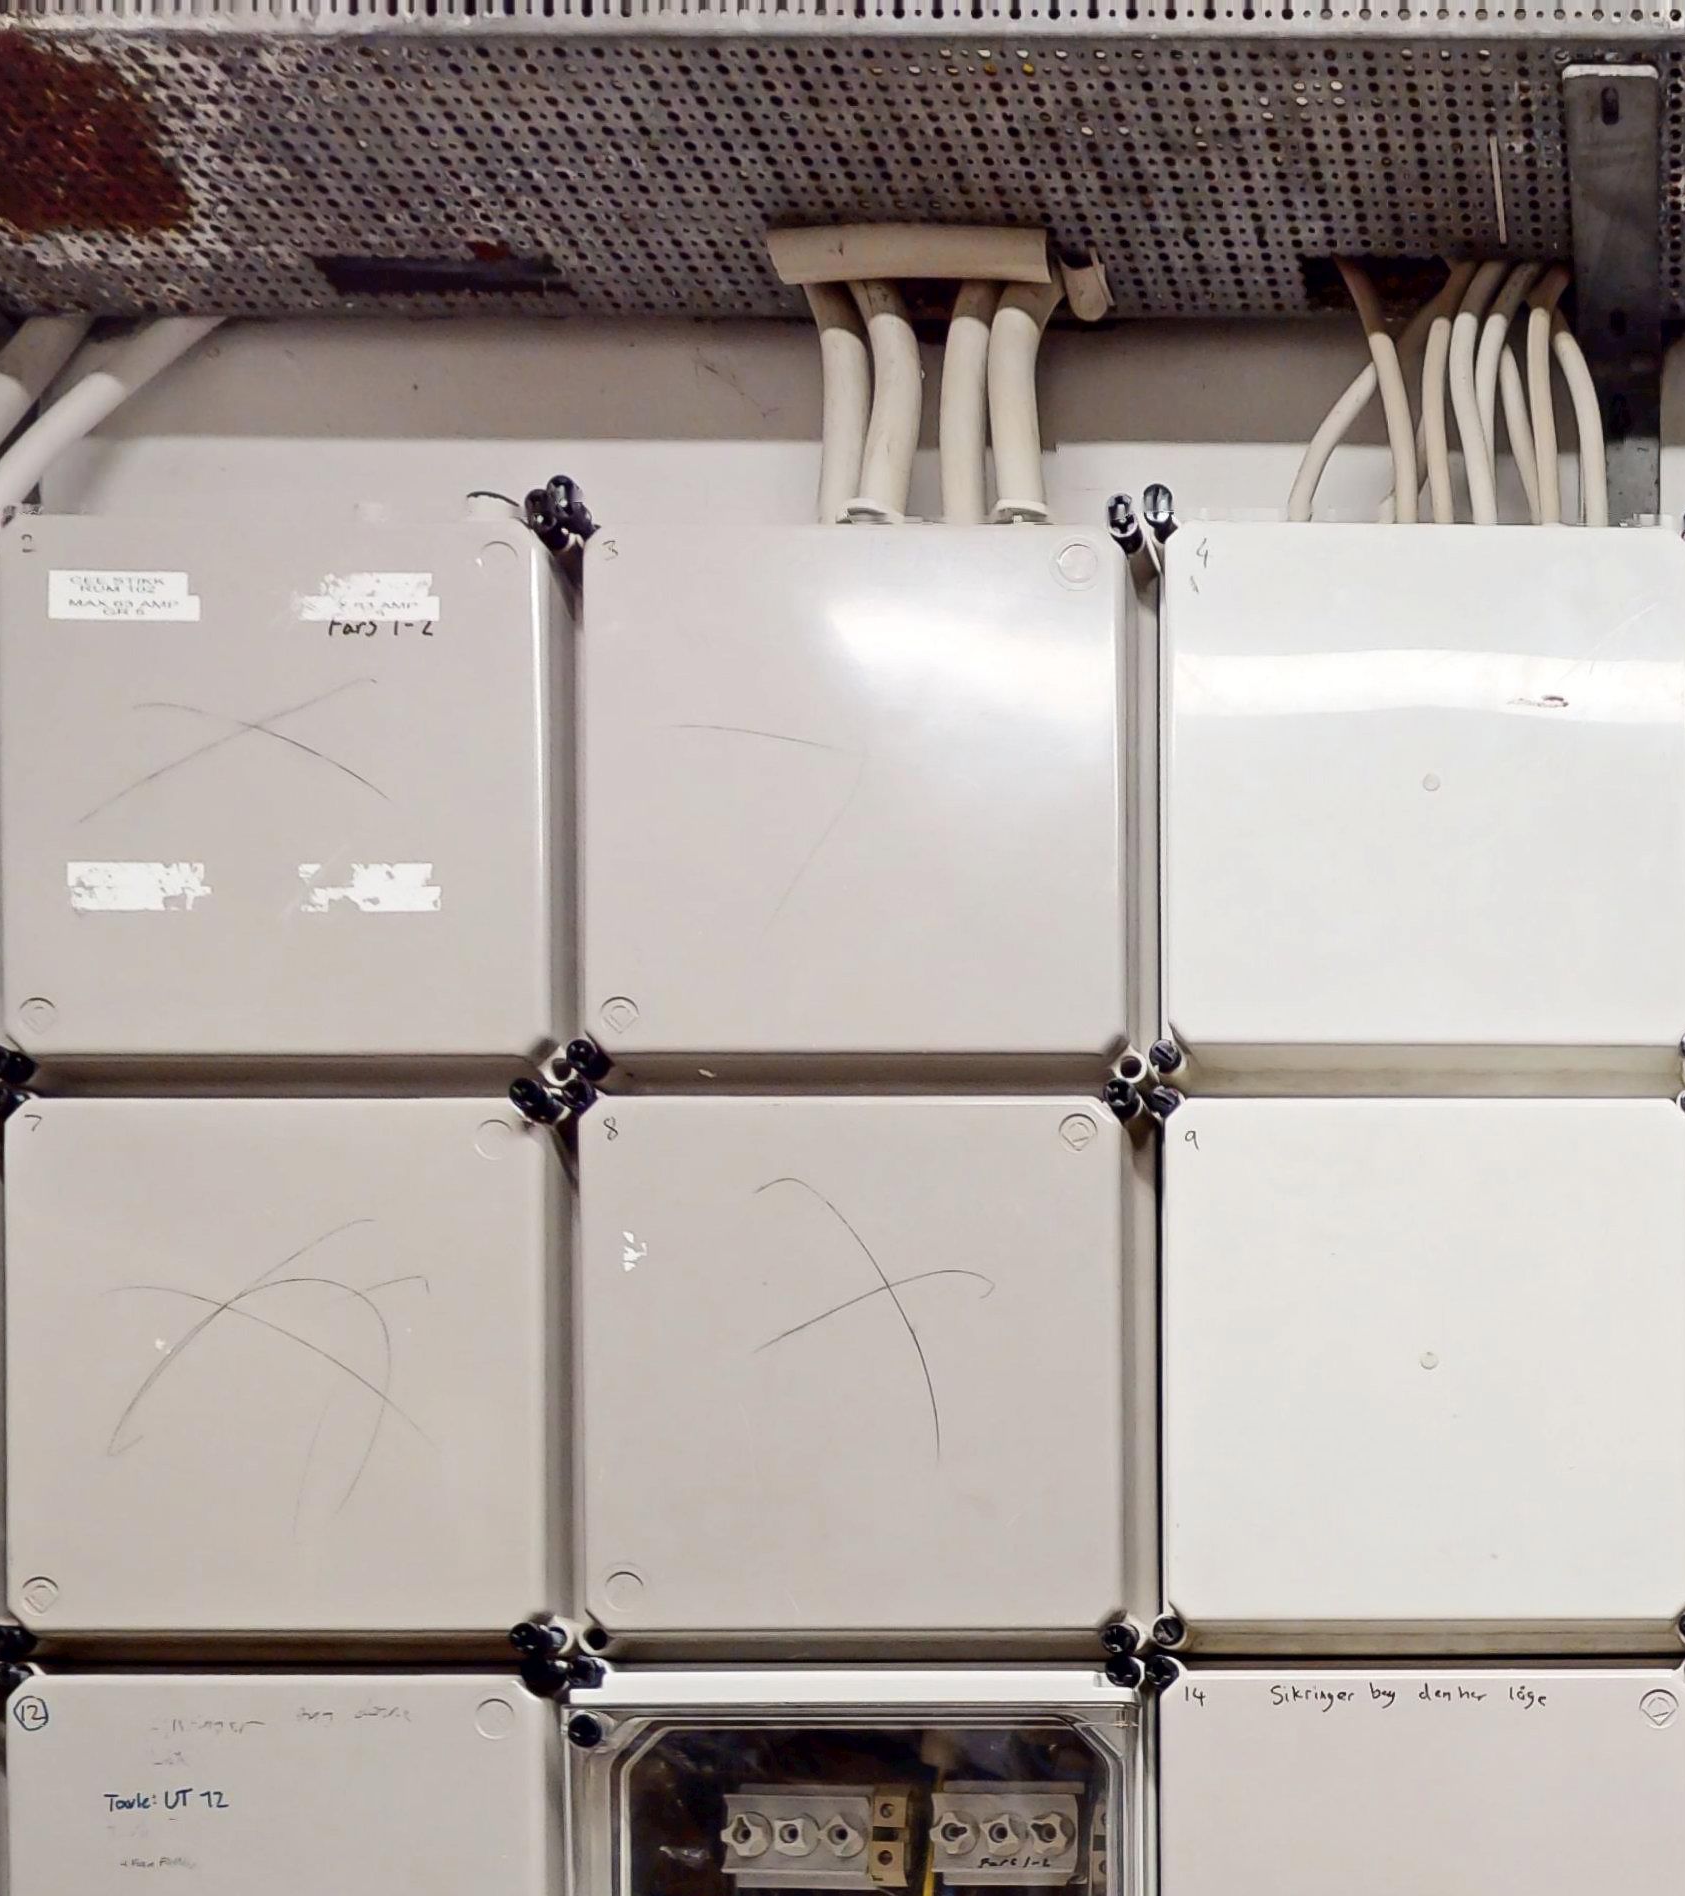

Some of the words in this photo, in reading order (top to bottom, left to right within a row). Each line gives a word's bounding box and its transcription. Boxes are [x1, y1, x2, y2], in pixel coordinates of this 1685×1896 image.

[601, 540, 619, 561] 3
[602, 1117, 619, 1141] 8
[1183, 1130, 1201, 1151] 9
[1184, 1685, 1206, 1702] 14
[1270, 1684, 1355, 1712] Sikringer
